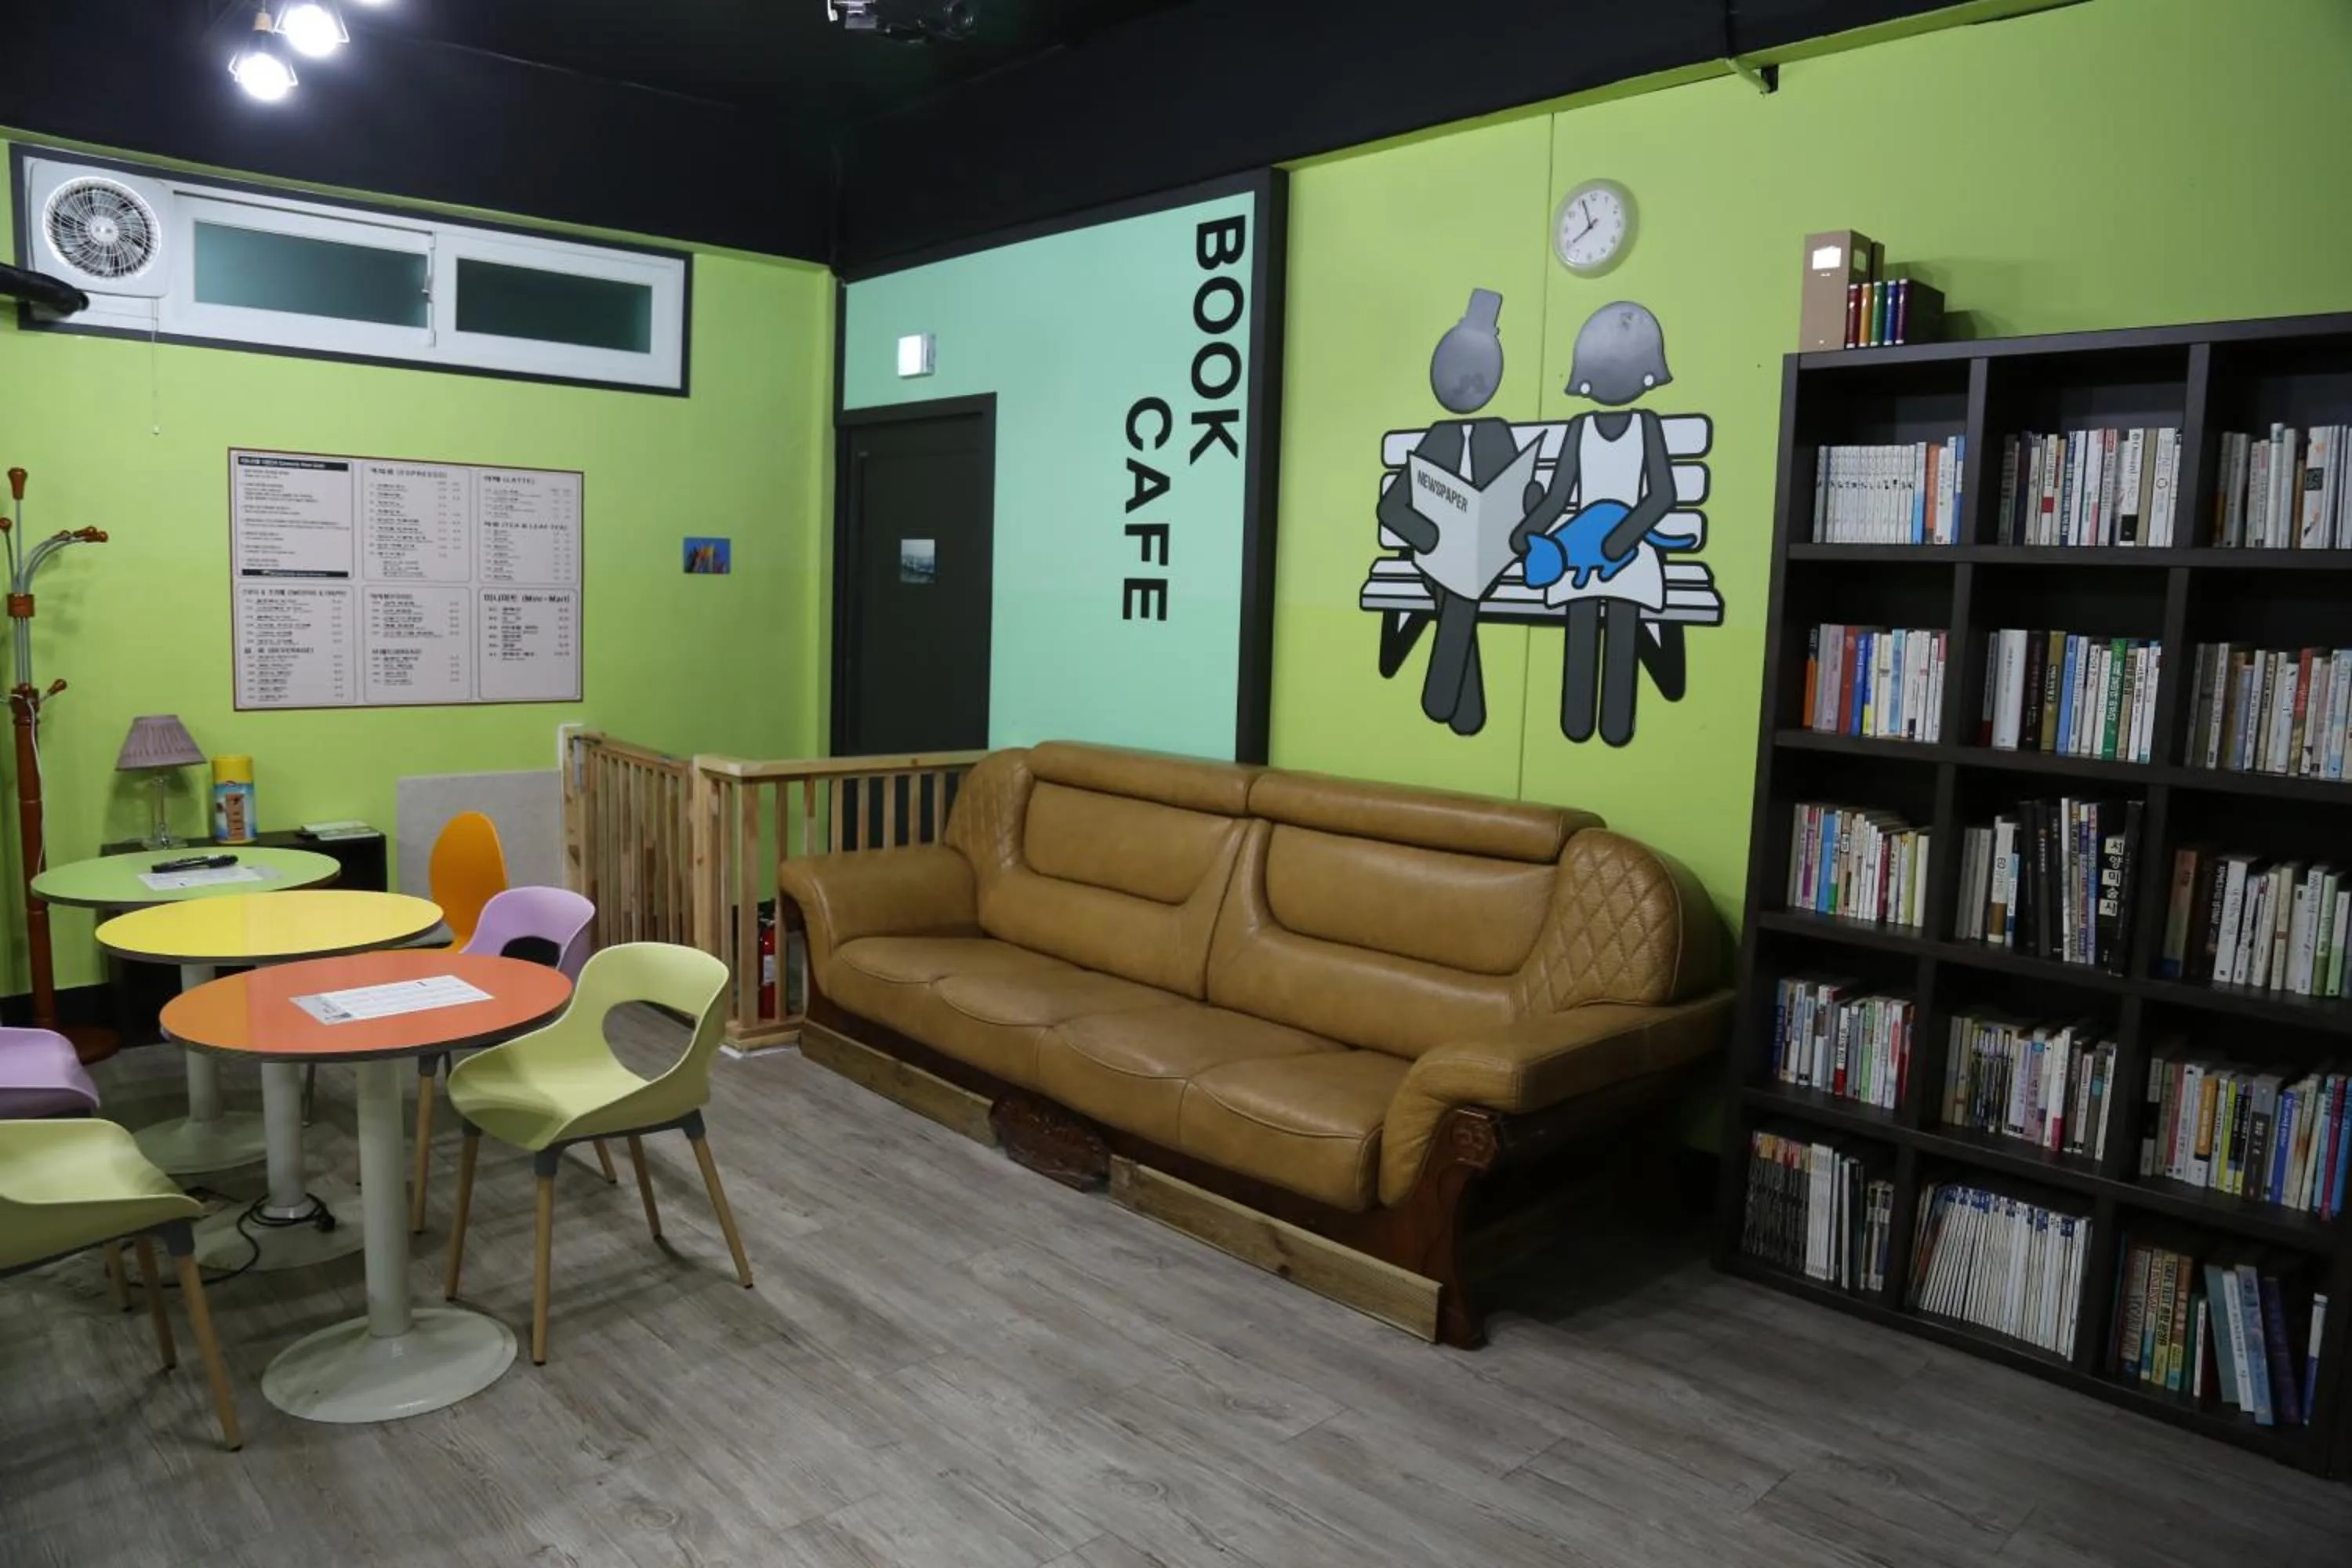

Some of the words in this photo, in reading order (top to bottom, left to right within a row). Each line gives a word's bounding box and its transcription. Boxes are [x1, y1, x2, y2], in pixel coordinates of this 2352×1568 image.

[1189, 215, 1246, 466] BOOK
[1123, 397, 1173, 621] CAFE
[1417, 470, 1468, 514] NEWSPAPER
